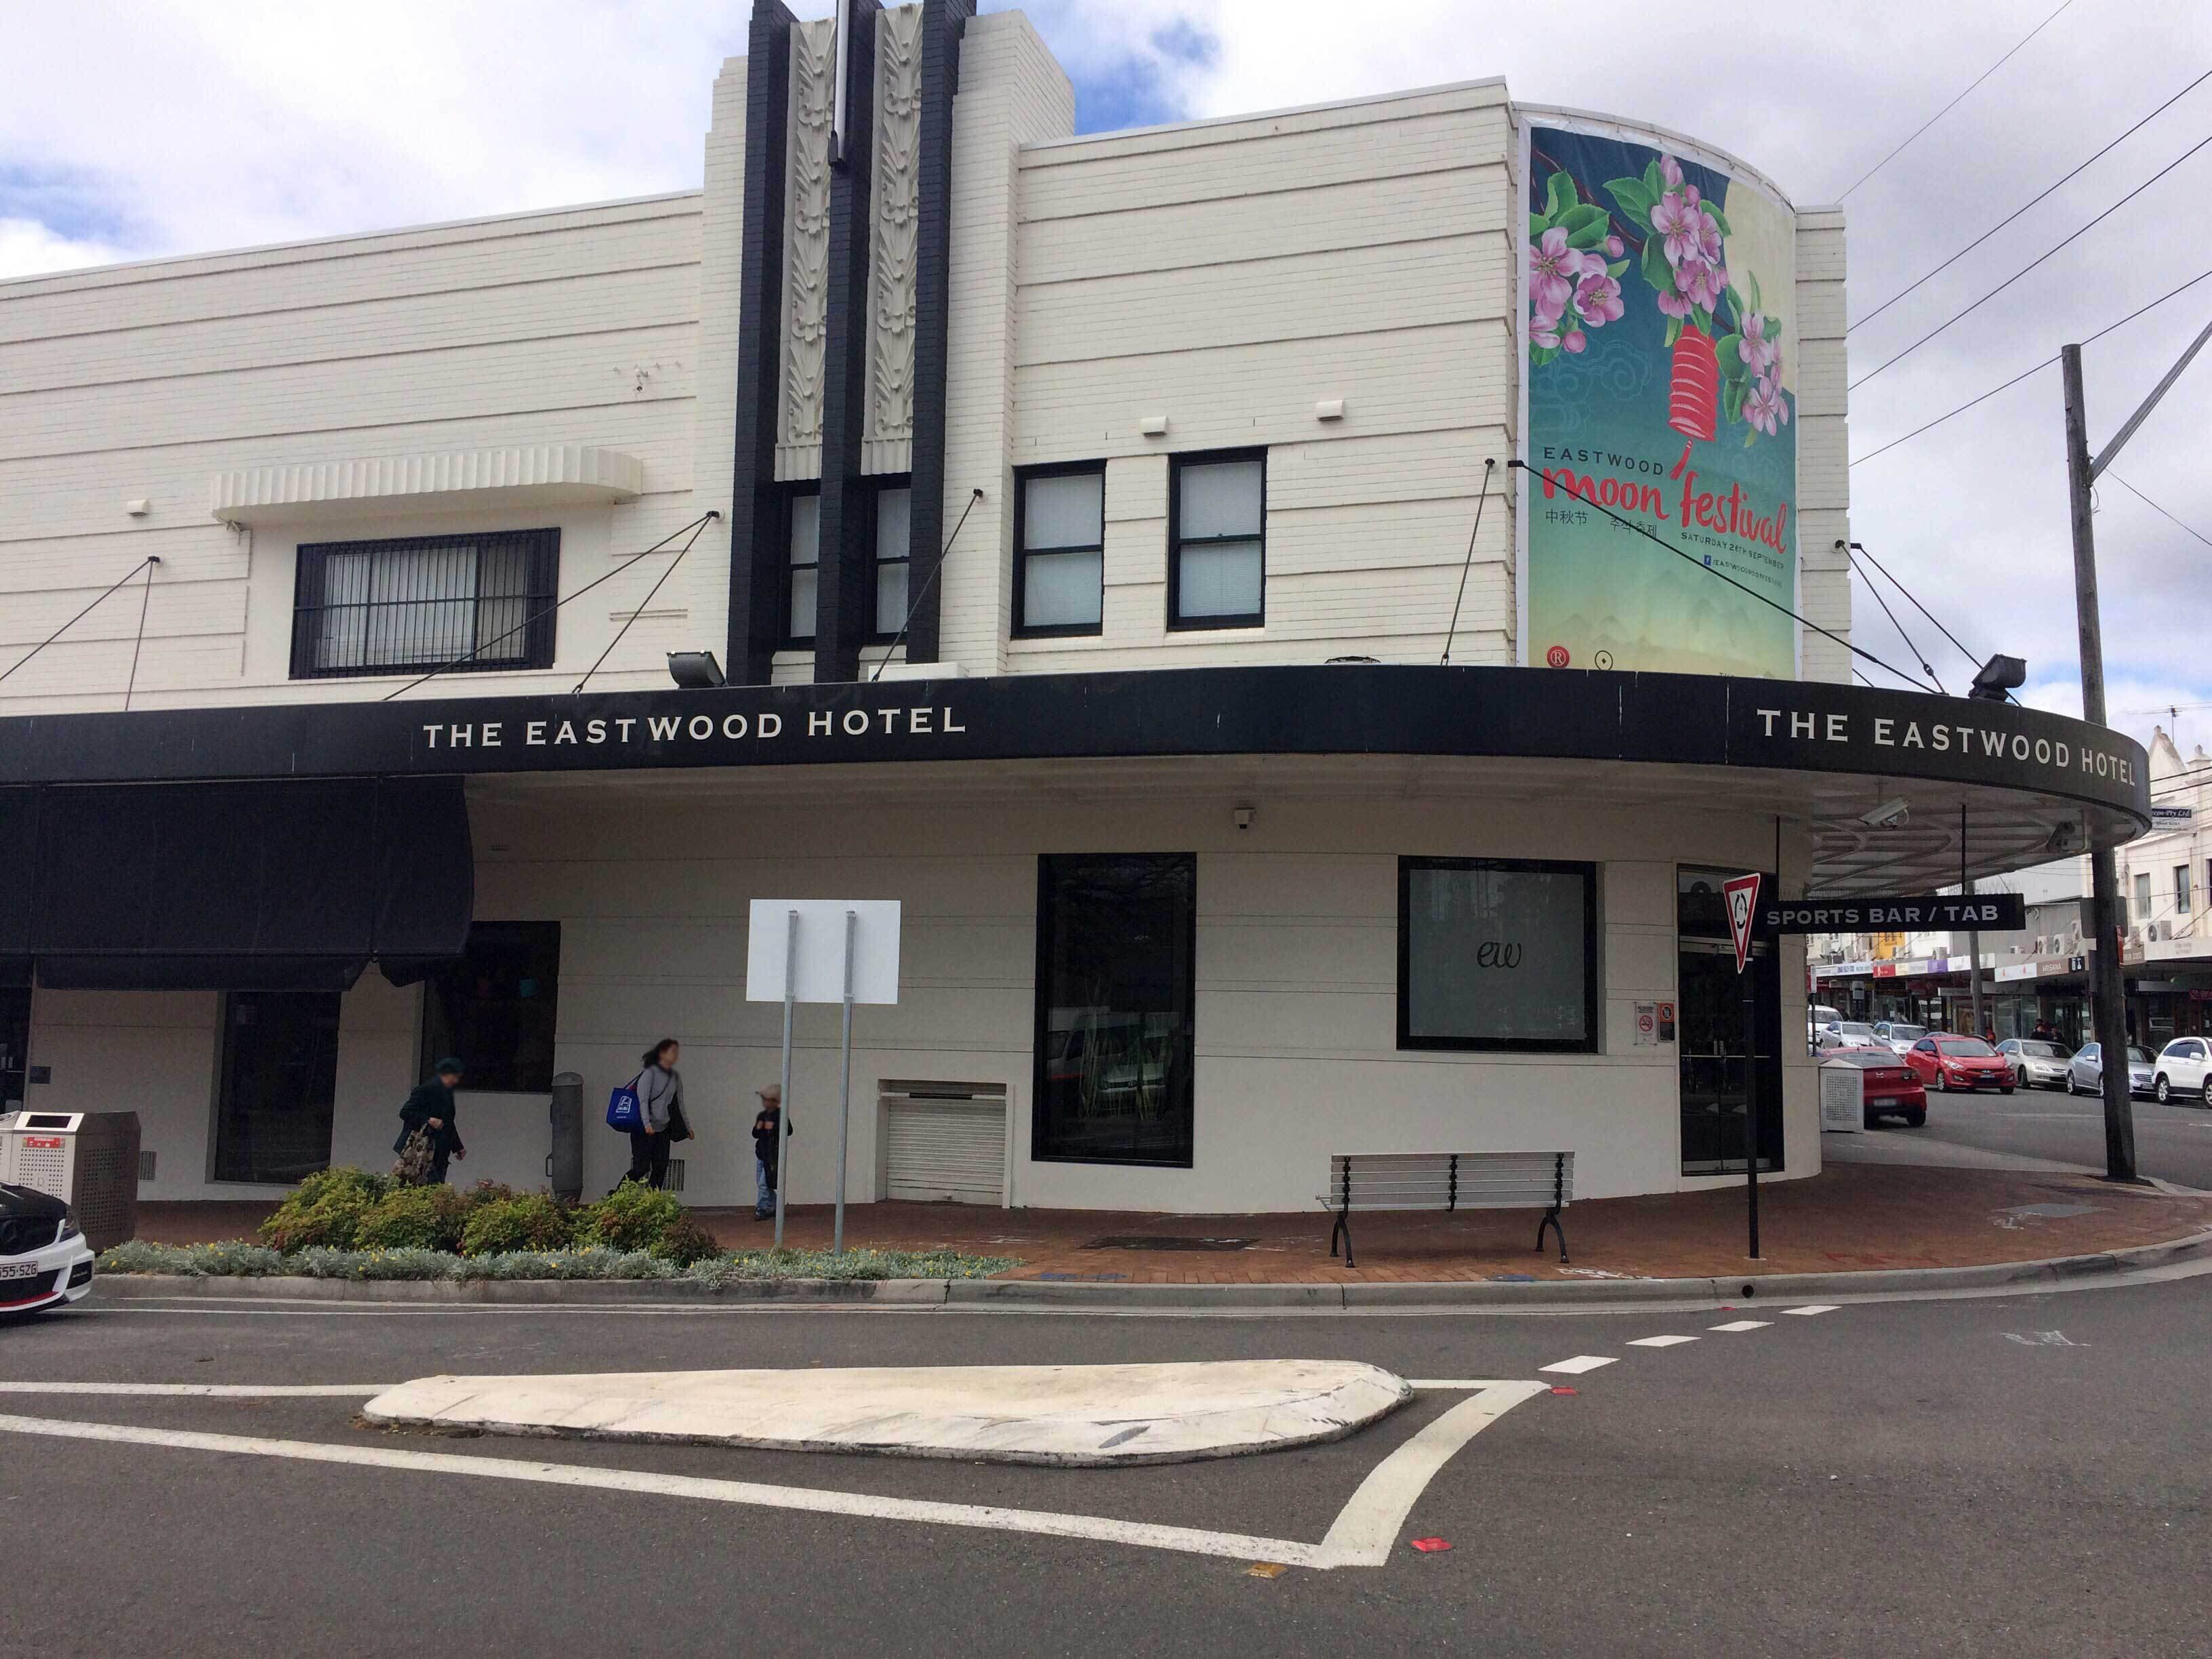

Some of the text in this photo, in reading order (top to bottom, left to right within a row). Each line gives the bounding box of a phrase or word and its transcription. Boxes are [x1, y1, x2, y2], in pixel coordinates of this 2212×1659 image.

[1543, 447, 1664, 476] EASTWOOD
[1542, 468, 1787, 554] moon festival
[1545, 509, 1589, 525] 中秋节
[1681, 532, 1727, 549] SATURDAY
[1748, 550, 1784, 571] SEPTEMBER
[423, 707, 966, 749] THE EASTWOOD HOTEL
[1757, 709, 2136, 787] THE EASTWOOD HOTEL
[1767, 907, 1860, 926] SPORTS
[1869, 905, 1921, 924] BAR
[1944, 904, 1999, 922] TAB
